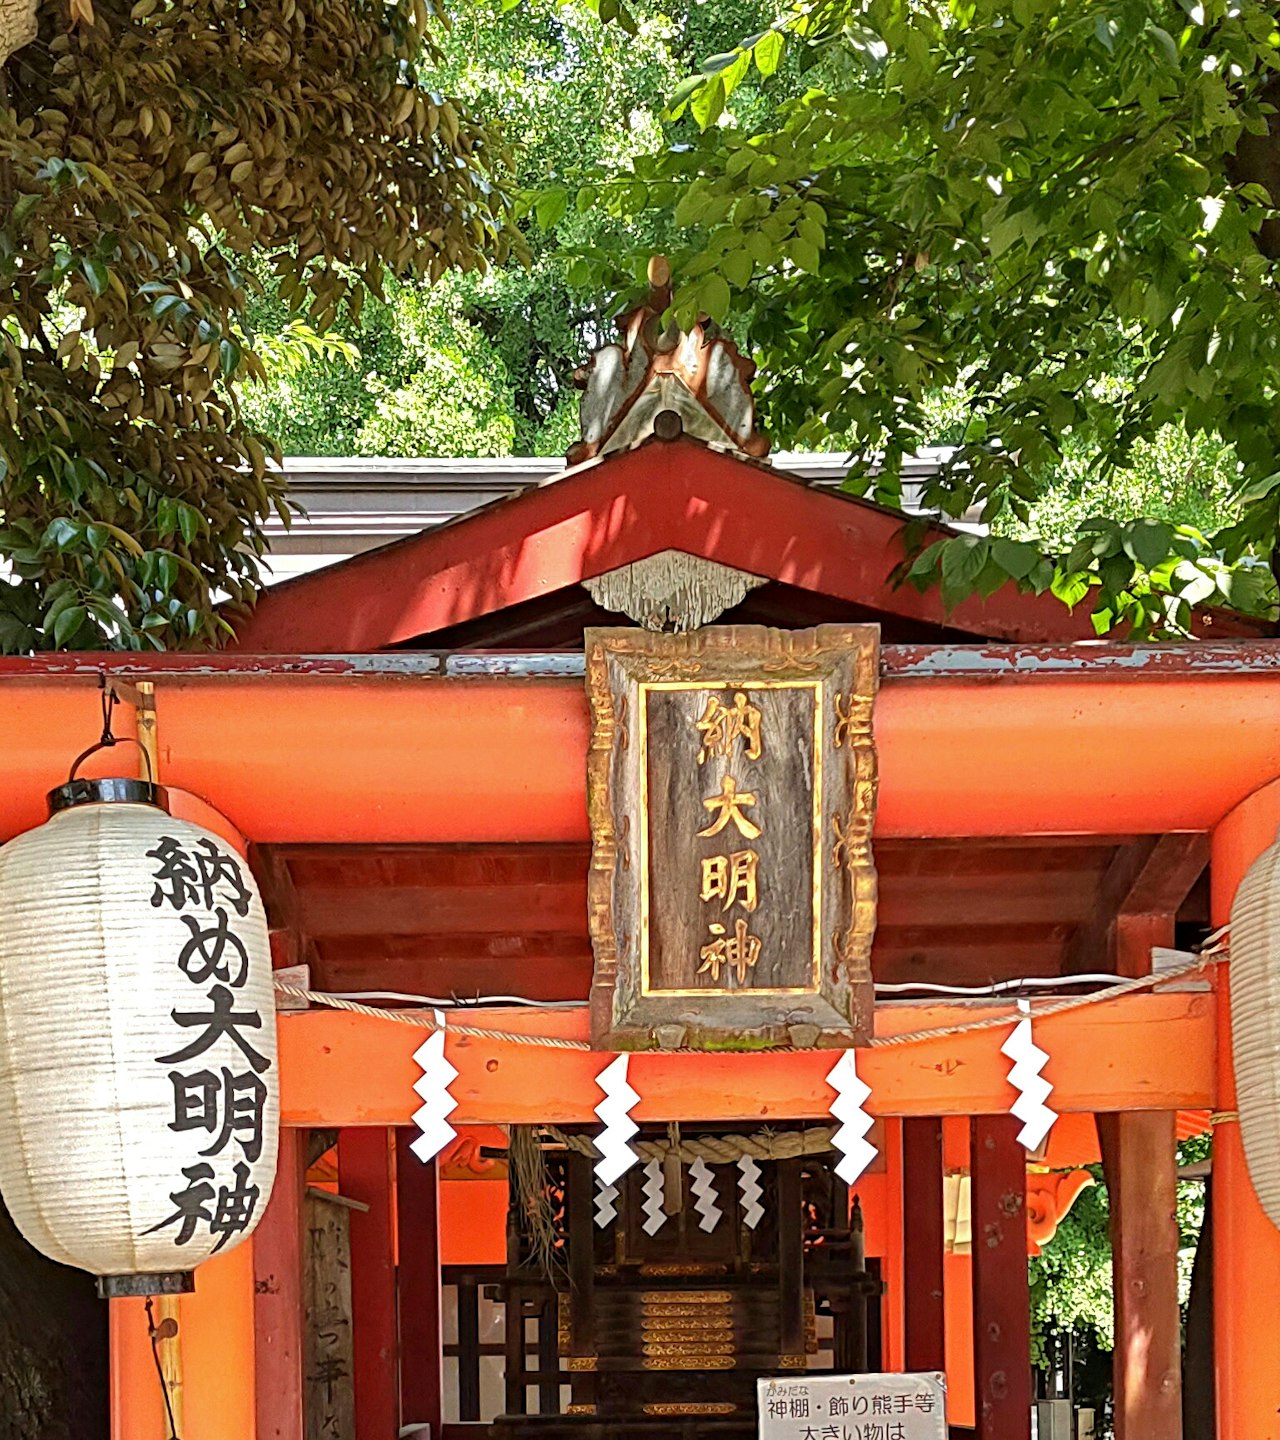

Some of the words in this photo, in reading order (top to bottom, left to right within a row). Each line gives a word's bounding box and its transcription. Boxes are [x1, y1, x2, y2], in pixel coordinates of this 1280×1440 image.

[696, 692, 762, 983] 納大明神
[138, 836, 272, 1255] 納め大明神
[767, 1392, 936, 1419] 神棚・飾り熊手等
